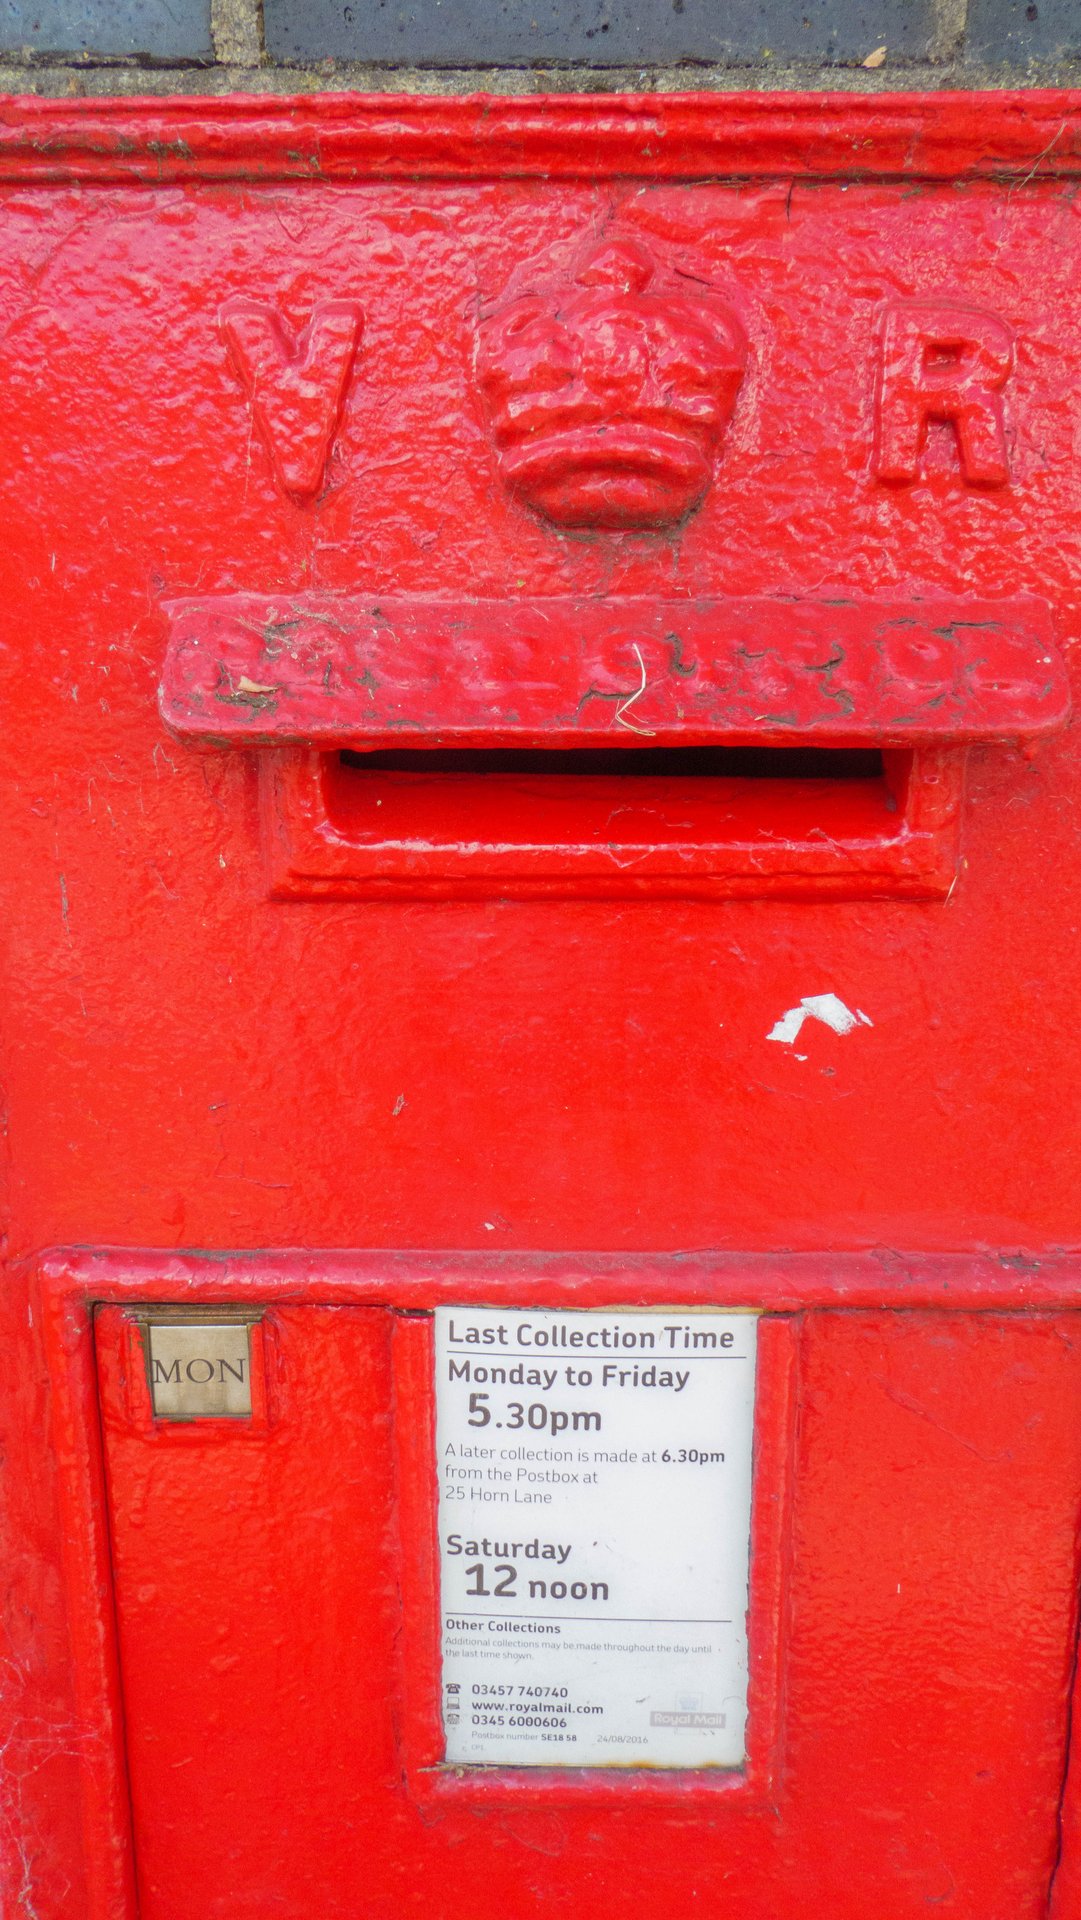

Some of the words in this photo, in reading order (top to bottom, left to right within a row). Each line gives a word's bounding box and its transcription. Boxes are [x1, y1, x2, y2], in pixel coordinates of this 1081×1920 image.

[217, 297, 365, 505] V
[876, 298, 1018, 491] R
[448, 1320, 508, 1345] Last
[517, 1324, 655, 1348] Collection
[664, 1326, 734, 1349] Time
[152, 1358, 246, 1384] MON
[448, 1359, 558, 1390] Monday
[565, 1366, 593, 1387] to
[602, 1364, 690, 1392] Friday
[467, 1393, 601, 1436] 5.30pm
[445, 1443, 456, 1457] A
[460, 1444, 496, 1459] later
[500, 1446, 573, 1462] collection
[578, 1449, 590, 1462] is
[594, 1449, 638, 1463] made
[641, 1450, 657, 1463] at
[661, 1449, 725, 1466] 6.30pm
[445, 1466, 483, 1480] from
[487, 1468, 512, 1481] the
[517, 1468, 579, 1483] Postbox
[583, 1472, 598, 1484] at
[445, 1486, 465, 1501] 25
[471, 1487, 509, 1502] Horn
[514, 1490, 552, 1504] Lane
[447, 1534, 572, 1564] Saturday
[465, 1563, 517, 1597] 12
[528, 1579, 609, 1600] noon
[446, 1619, 484, 1630] Other
[488, 1620, 561, 1634] Collections
[445, 1636, 490, 1646] Additional
[492, 1638, 539, 1648] collections
[577, 1642, 601, 1651] made
[604, 1644, 654, 1653] throughout
[656, 1644, 671, 1652] the
[674, 1645, 688, 1654] day
[480, 1650, 500, 1658] time
[502, 1651, 534, 1660] shown.
[472, 1684, 513, 1695] 03457
[518, 1686, 568, 1697] 740740
[472, 1702, 603, 1714] www.royalmail.com
[472, 1715, 505, 1725] 0345
[509, 1717, 567, 1727] 6000606
[654, 1713, 691, 1726] Royal
[693, 1715, 722, 1725] Mail
[472, 1731, 504, 1739] Postbox
[566, 1734, 577, 1742] 58
[597, 1735, 648, 1744] 24/08/2016
